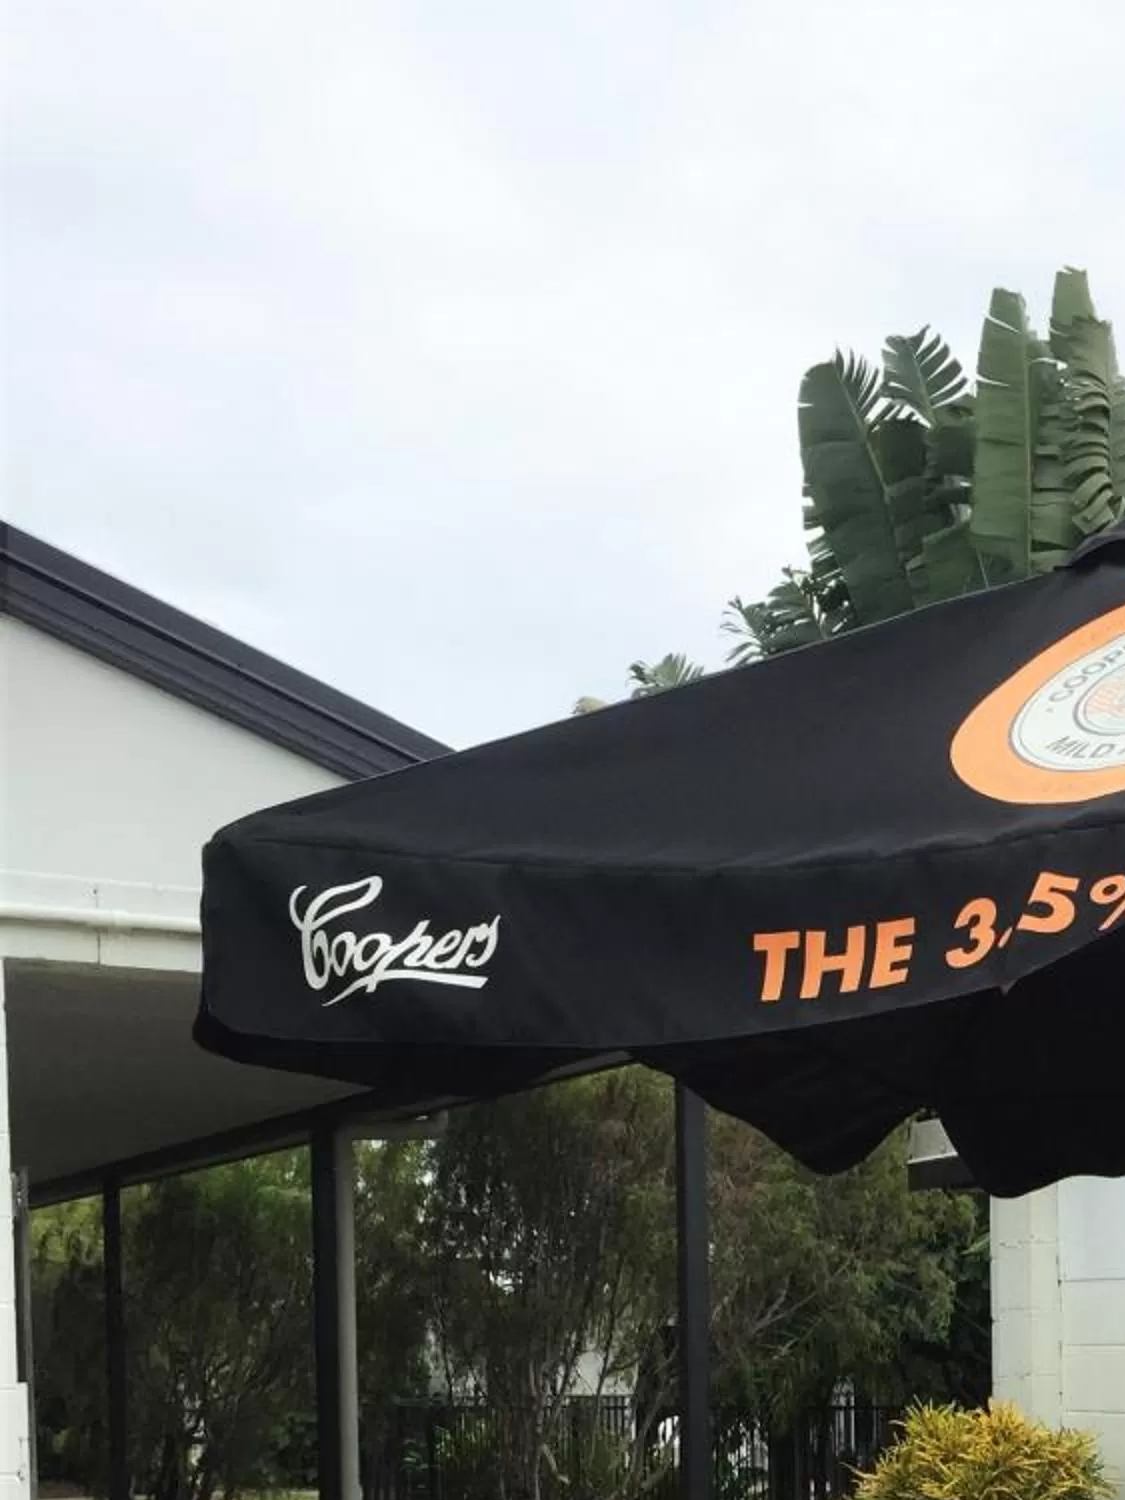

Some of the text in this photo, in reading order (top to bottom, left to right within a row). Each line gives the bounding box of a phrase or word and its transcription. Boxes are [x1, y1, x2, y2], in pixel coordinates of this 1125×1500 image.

[1045, 735, 1115, 759] MILD
[289, 875, 501, 1007] Coopers
[753, 917, 916, 1002] THE
